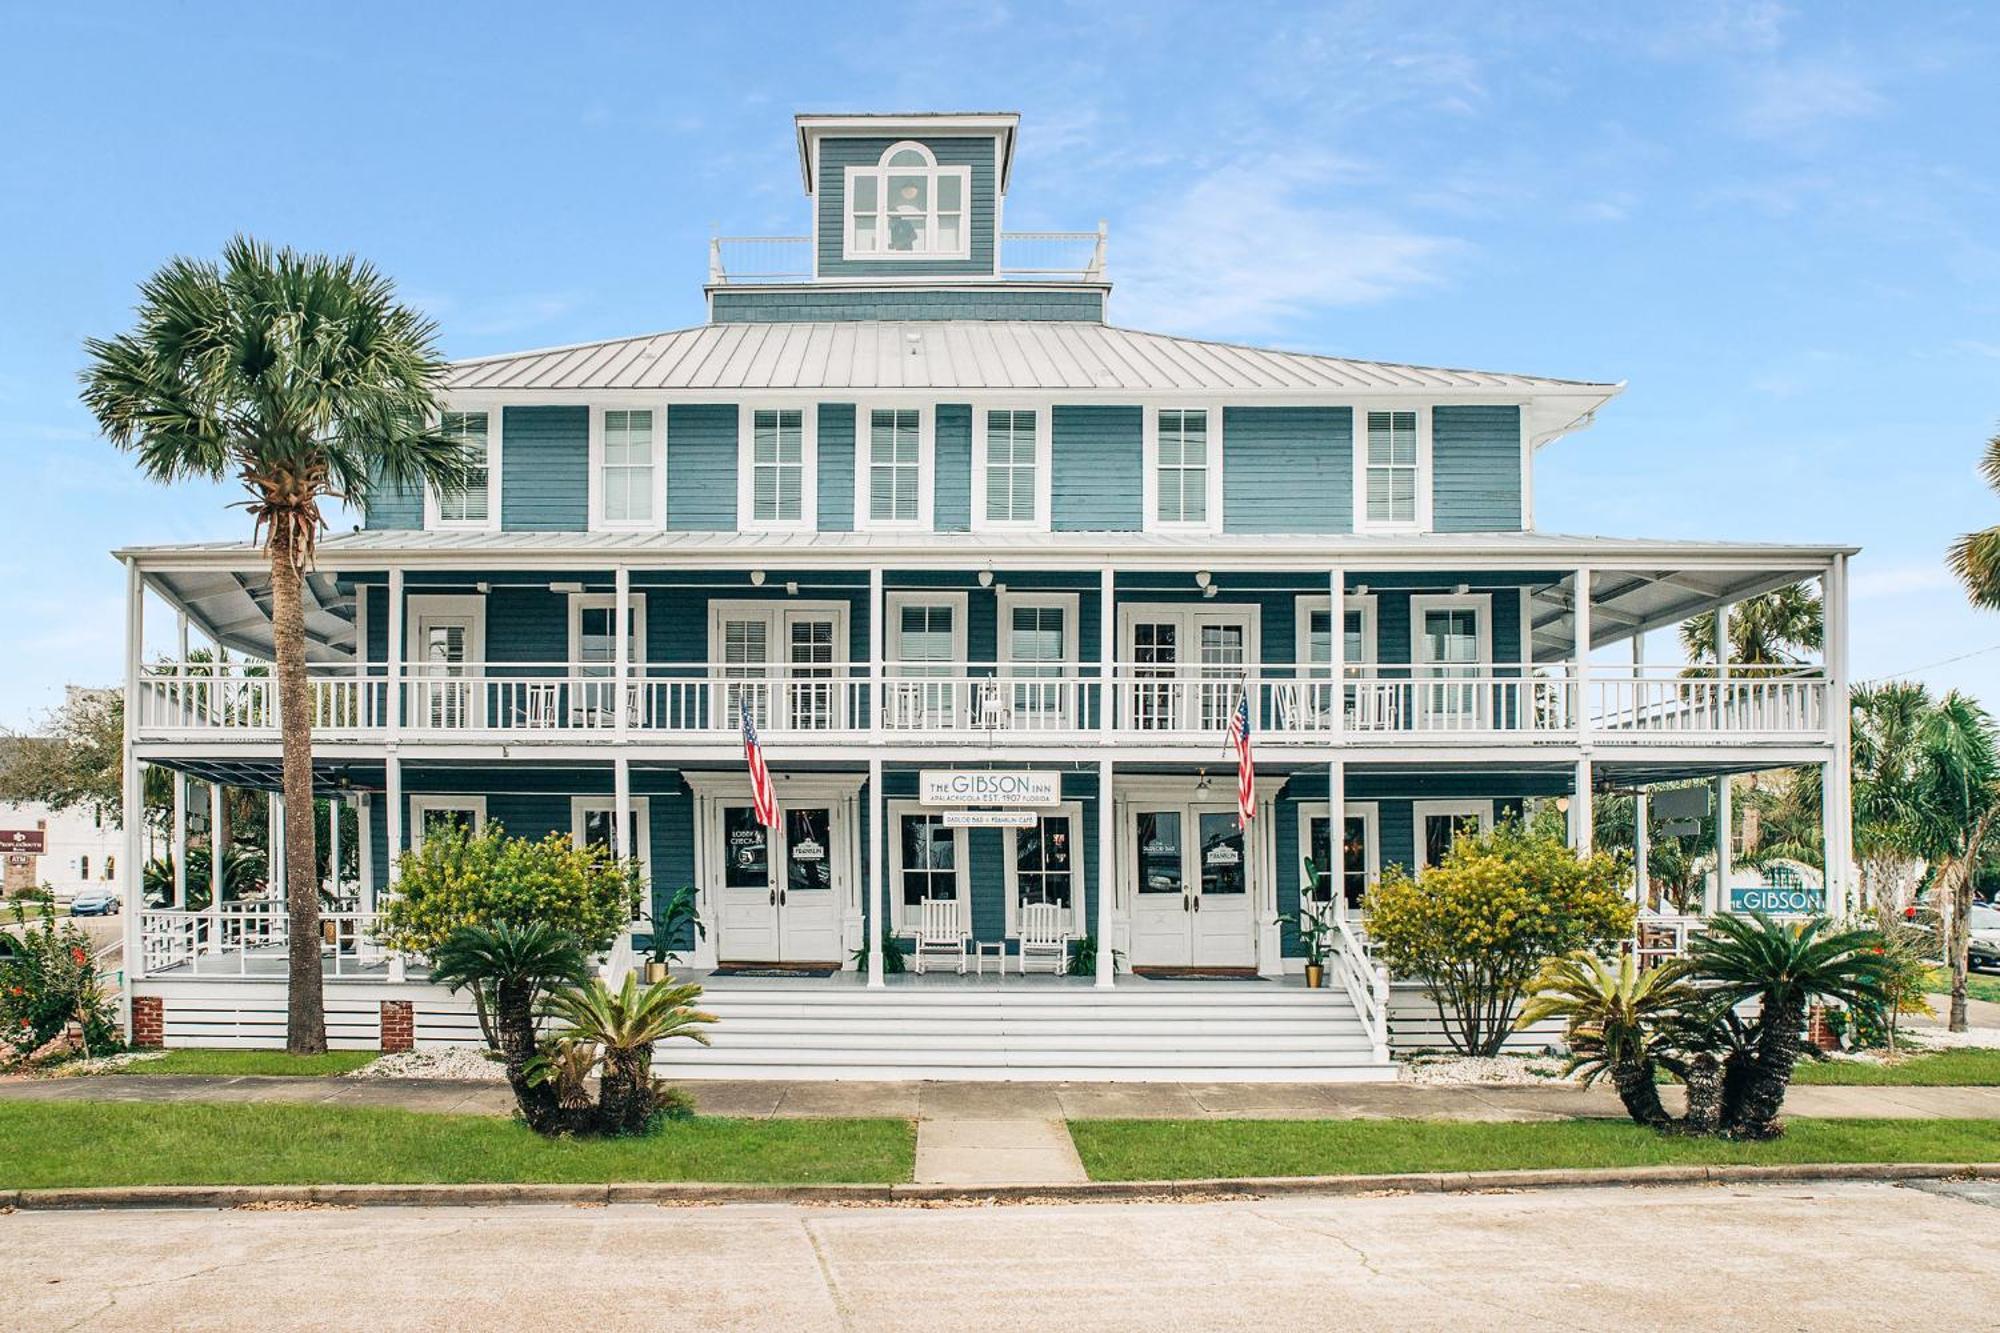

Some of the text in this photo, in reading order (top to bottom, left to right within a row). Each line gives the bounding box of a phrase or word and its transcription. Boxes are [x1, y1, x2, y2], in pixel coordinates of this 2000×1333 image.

[930, 775, 1051, 793] THE GIBSON INN
[1743, 891, 1820, 909] GIBSON
